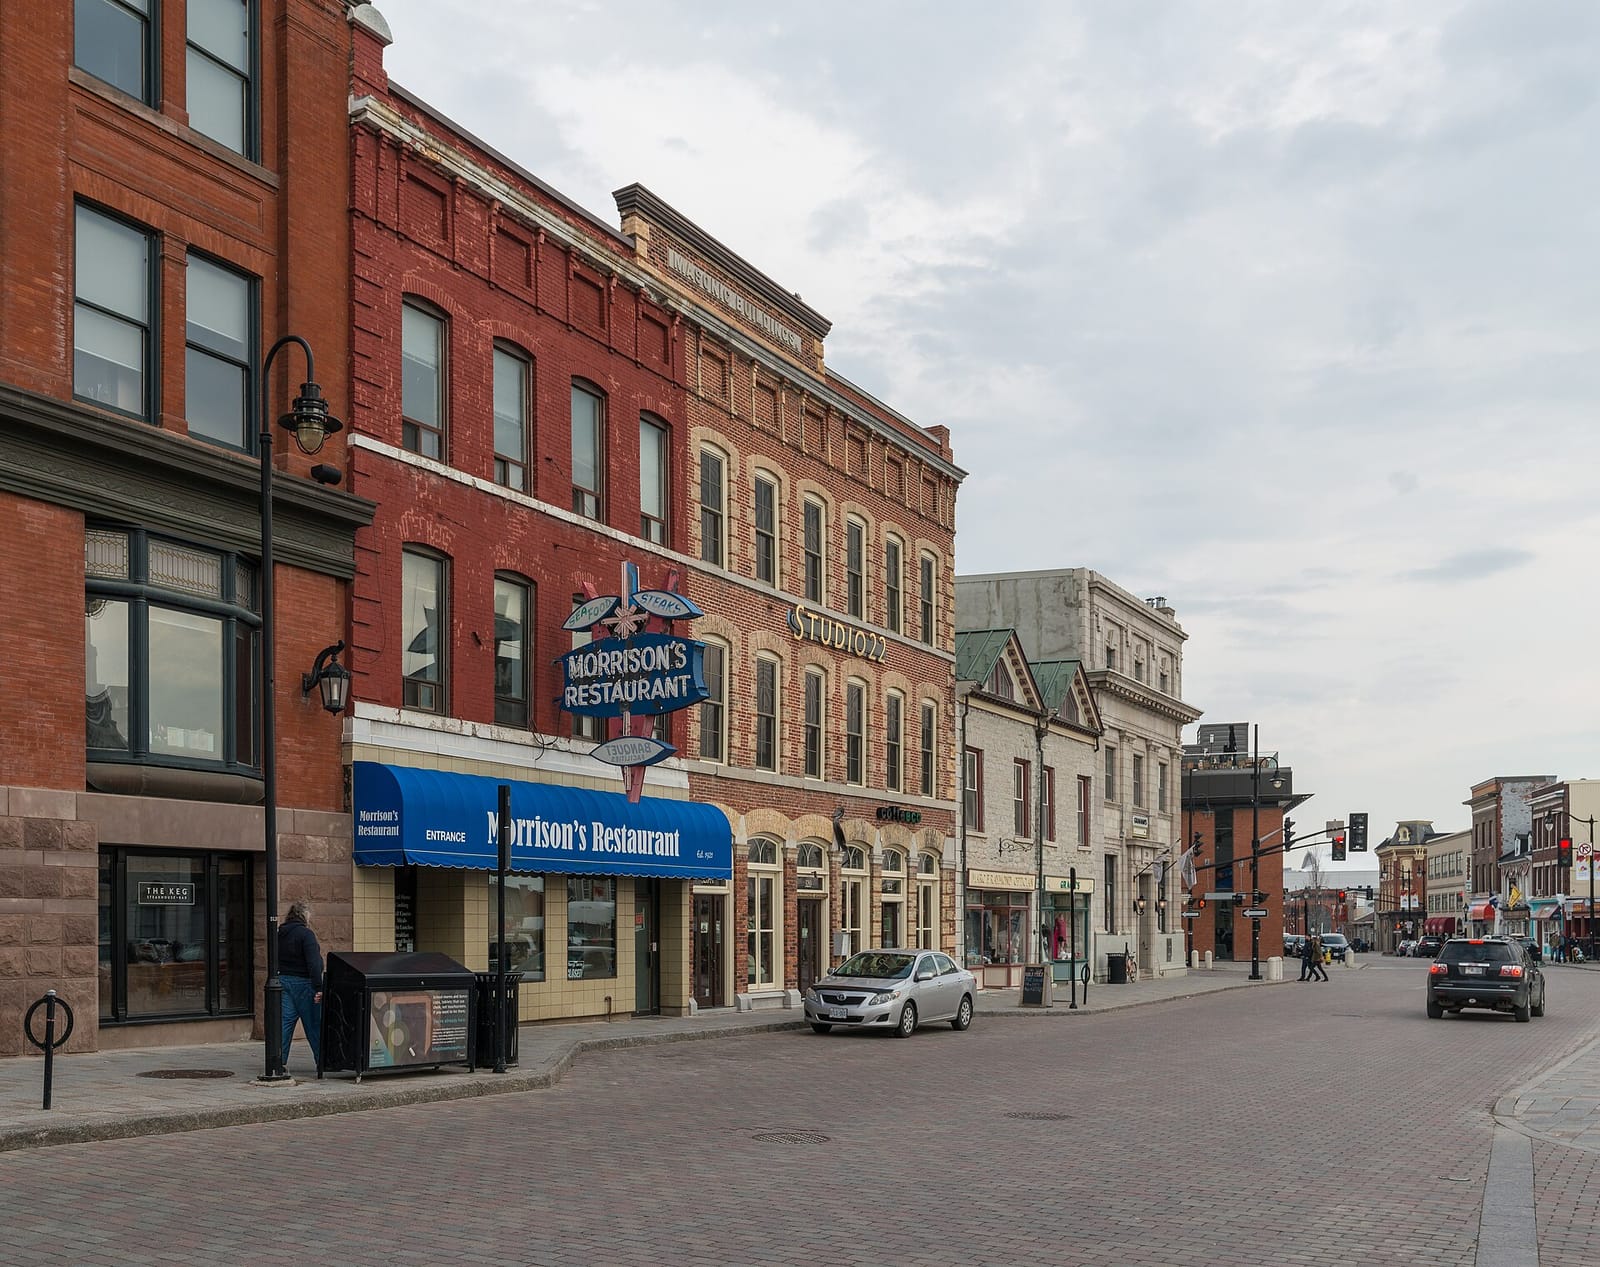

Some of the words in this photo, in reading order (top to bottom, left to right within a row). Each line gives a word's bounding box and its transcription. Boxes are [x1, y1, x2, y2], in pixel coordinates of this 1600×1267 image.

[673, 252, 730, 303] MASONIC
[641, 593, 681, 614] STEAKS
[567, 640, 688, 679] MORRISON'S
[564, 675, 691, 707] RESTAURANT
[359, 810, 399, 821] Morrison's
[358, 825, 400, 836] Restaurant
[426, 829, 466, 842] ENTRANCE
[592, 822, 680, 857] Restaurant
[147, 887, 165, 895] THE
[169, 887, 188, 896] KEG
